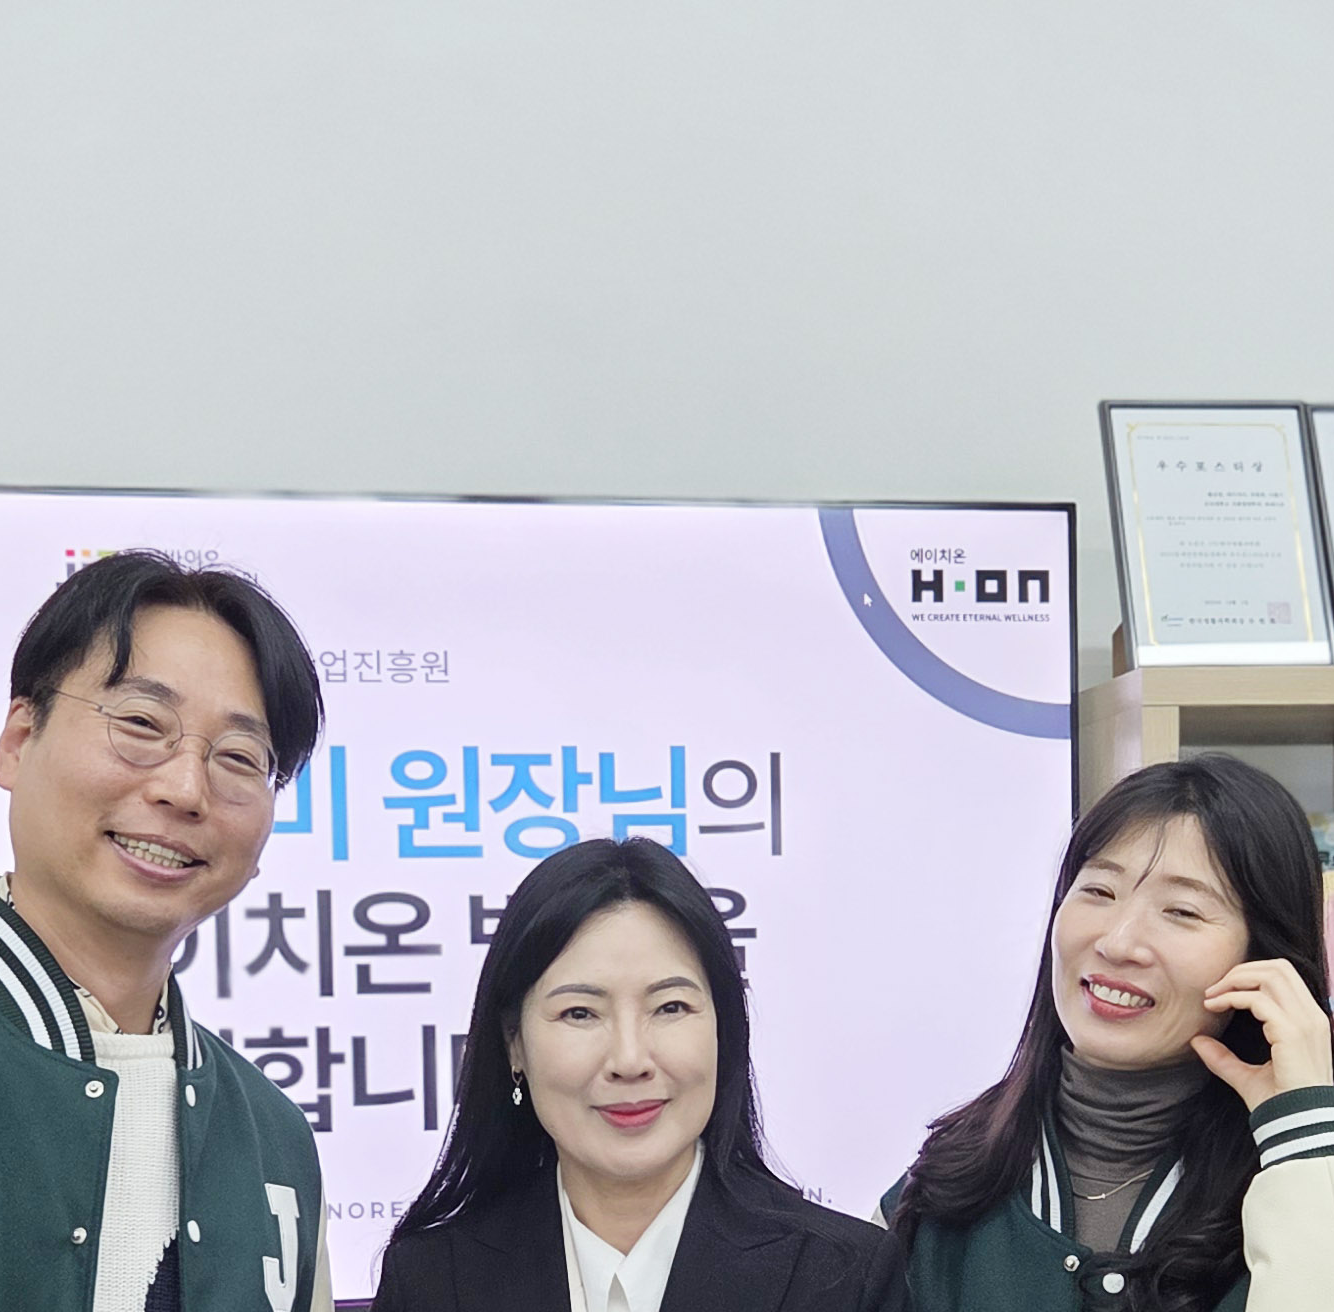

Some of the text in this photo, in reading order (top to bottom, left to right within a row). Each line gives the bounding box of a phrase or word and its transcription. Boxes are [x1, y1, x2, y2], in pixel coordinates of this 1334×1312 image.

[910, 548, 966, 565] 에이치온
[911, 613, 1051, 622] WE CREATE ETERNAL WELLNESS
